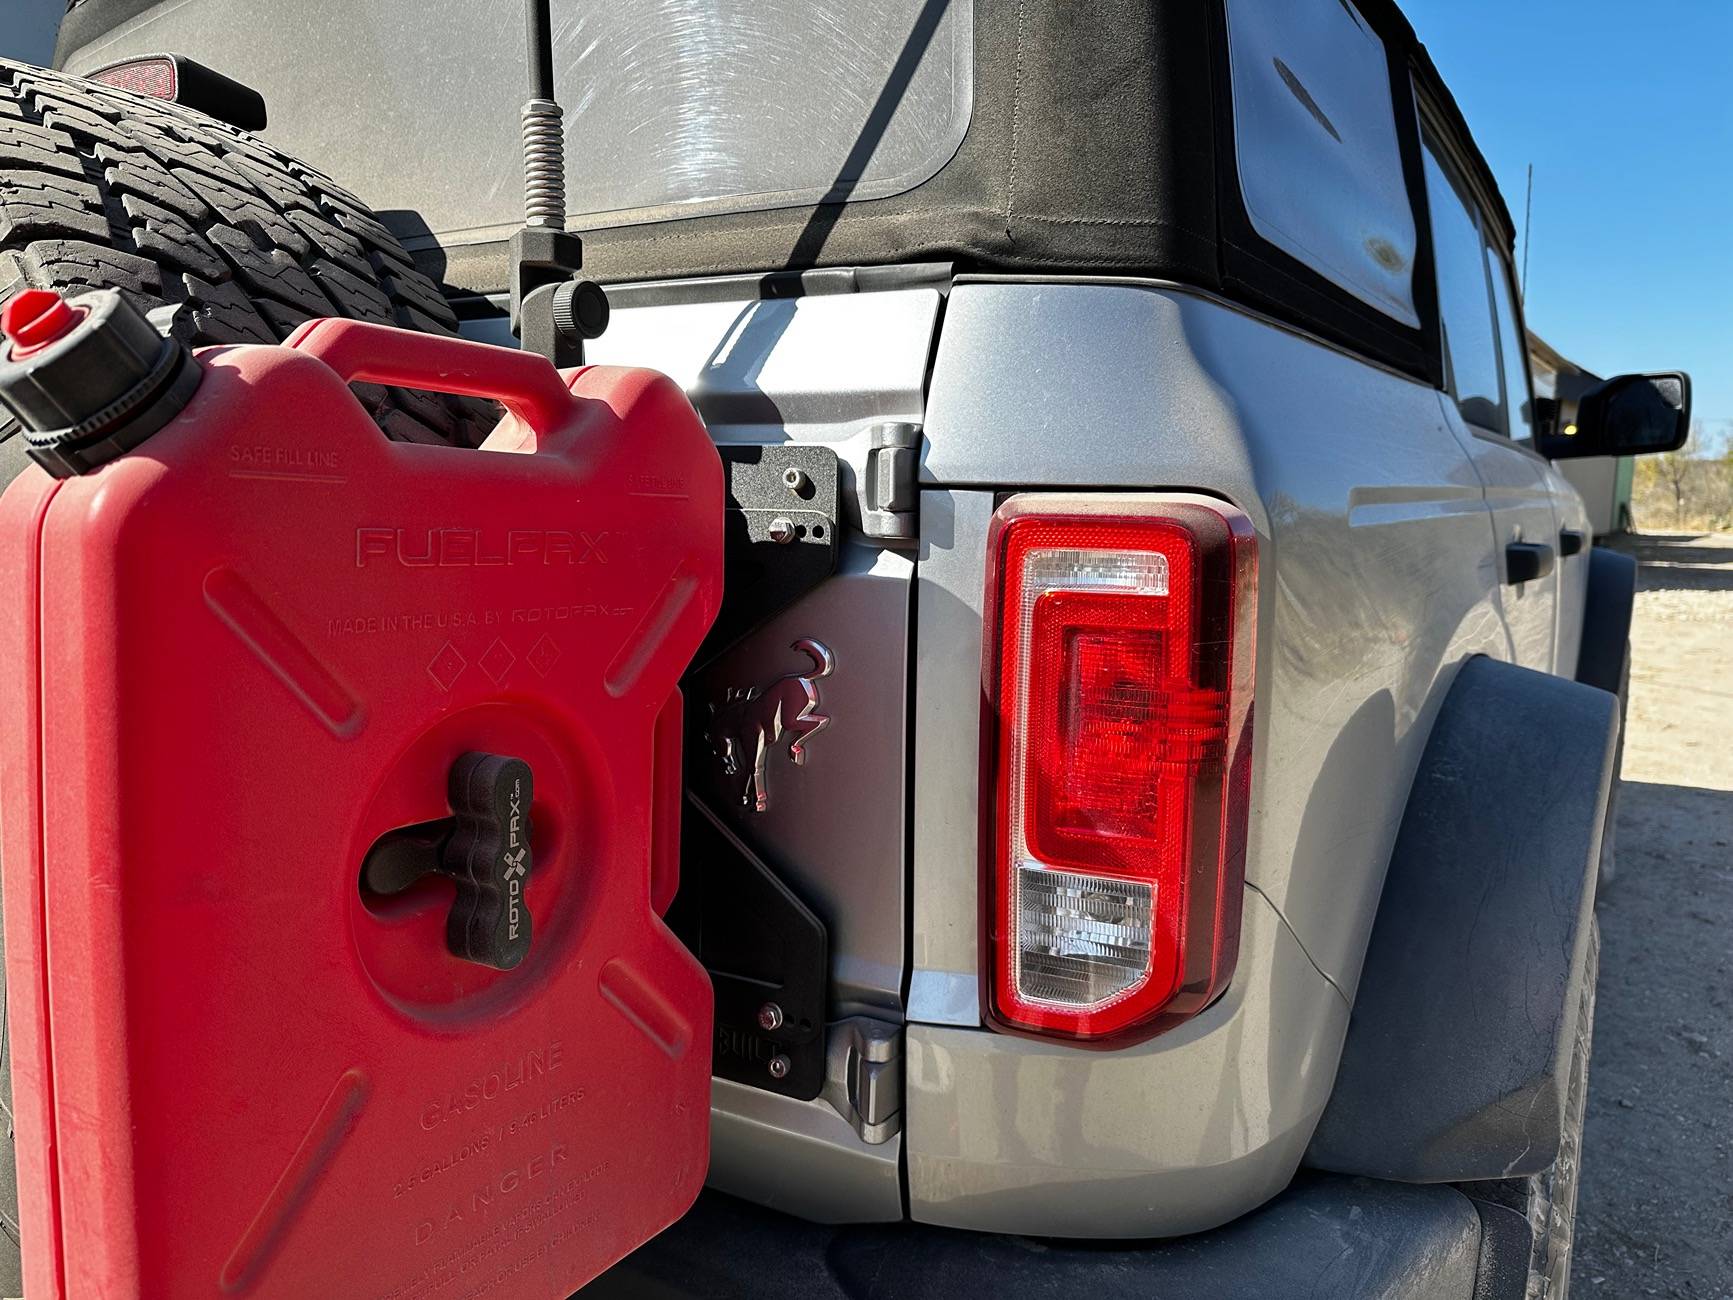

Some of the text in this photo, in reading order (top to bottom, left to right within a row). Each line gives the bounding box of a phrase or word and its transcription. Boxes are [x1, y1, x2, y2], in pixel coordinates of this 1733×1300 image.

[231, 444, 338, 468] SAFE FILL LINE
[328, 616, 376, 636] MADE
[382, 615, 400, 633] IN
[402, 613, 432, 632] THE
[485, 609, 504, 625] BY
[420, 1041, 563, 1131] GASOLINE
[420, 1135, 490, 1183] GALLONS
[540, 1087, 587, 1119] LITERS
[415, 1144, 569, 1246] DANGER
